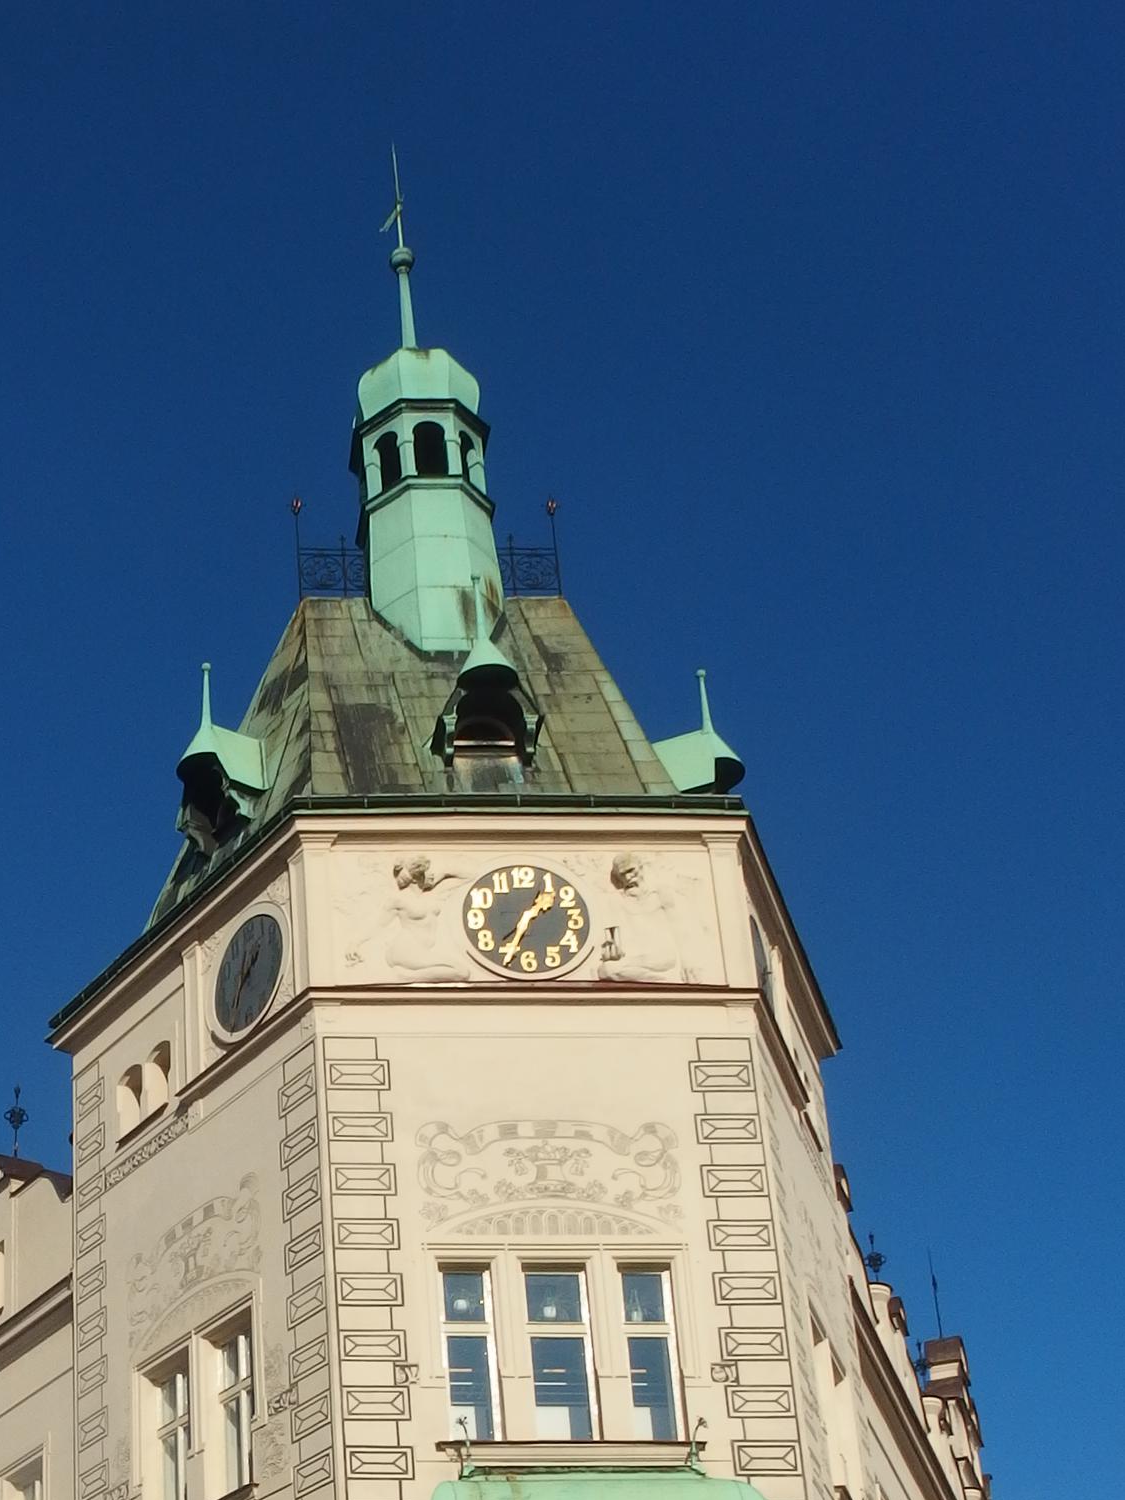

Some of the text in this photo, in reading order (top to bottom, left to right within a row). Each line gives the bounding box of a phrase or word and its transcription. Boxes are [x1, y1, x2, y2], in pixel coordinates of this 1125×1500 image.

[492, 872, 509, 894] 11
[511, 866, 535, 889] 12
[543, 872, 555, 893] 1
[470, 888, 493, 909] 10
[559, 886, 576, 908] 2
[467, 908, 485, 930] 9
[567, 908, 584, 930] 3
[477, 930, 495, 951] 8
[559, 930, 578, 953] 4
[520, 951, 537, 973] 6
[544, 946, 561, 968] 5
